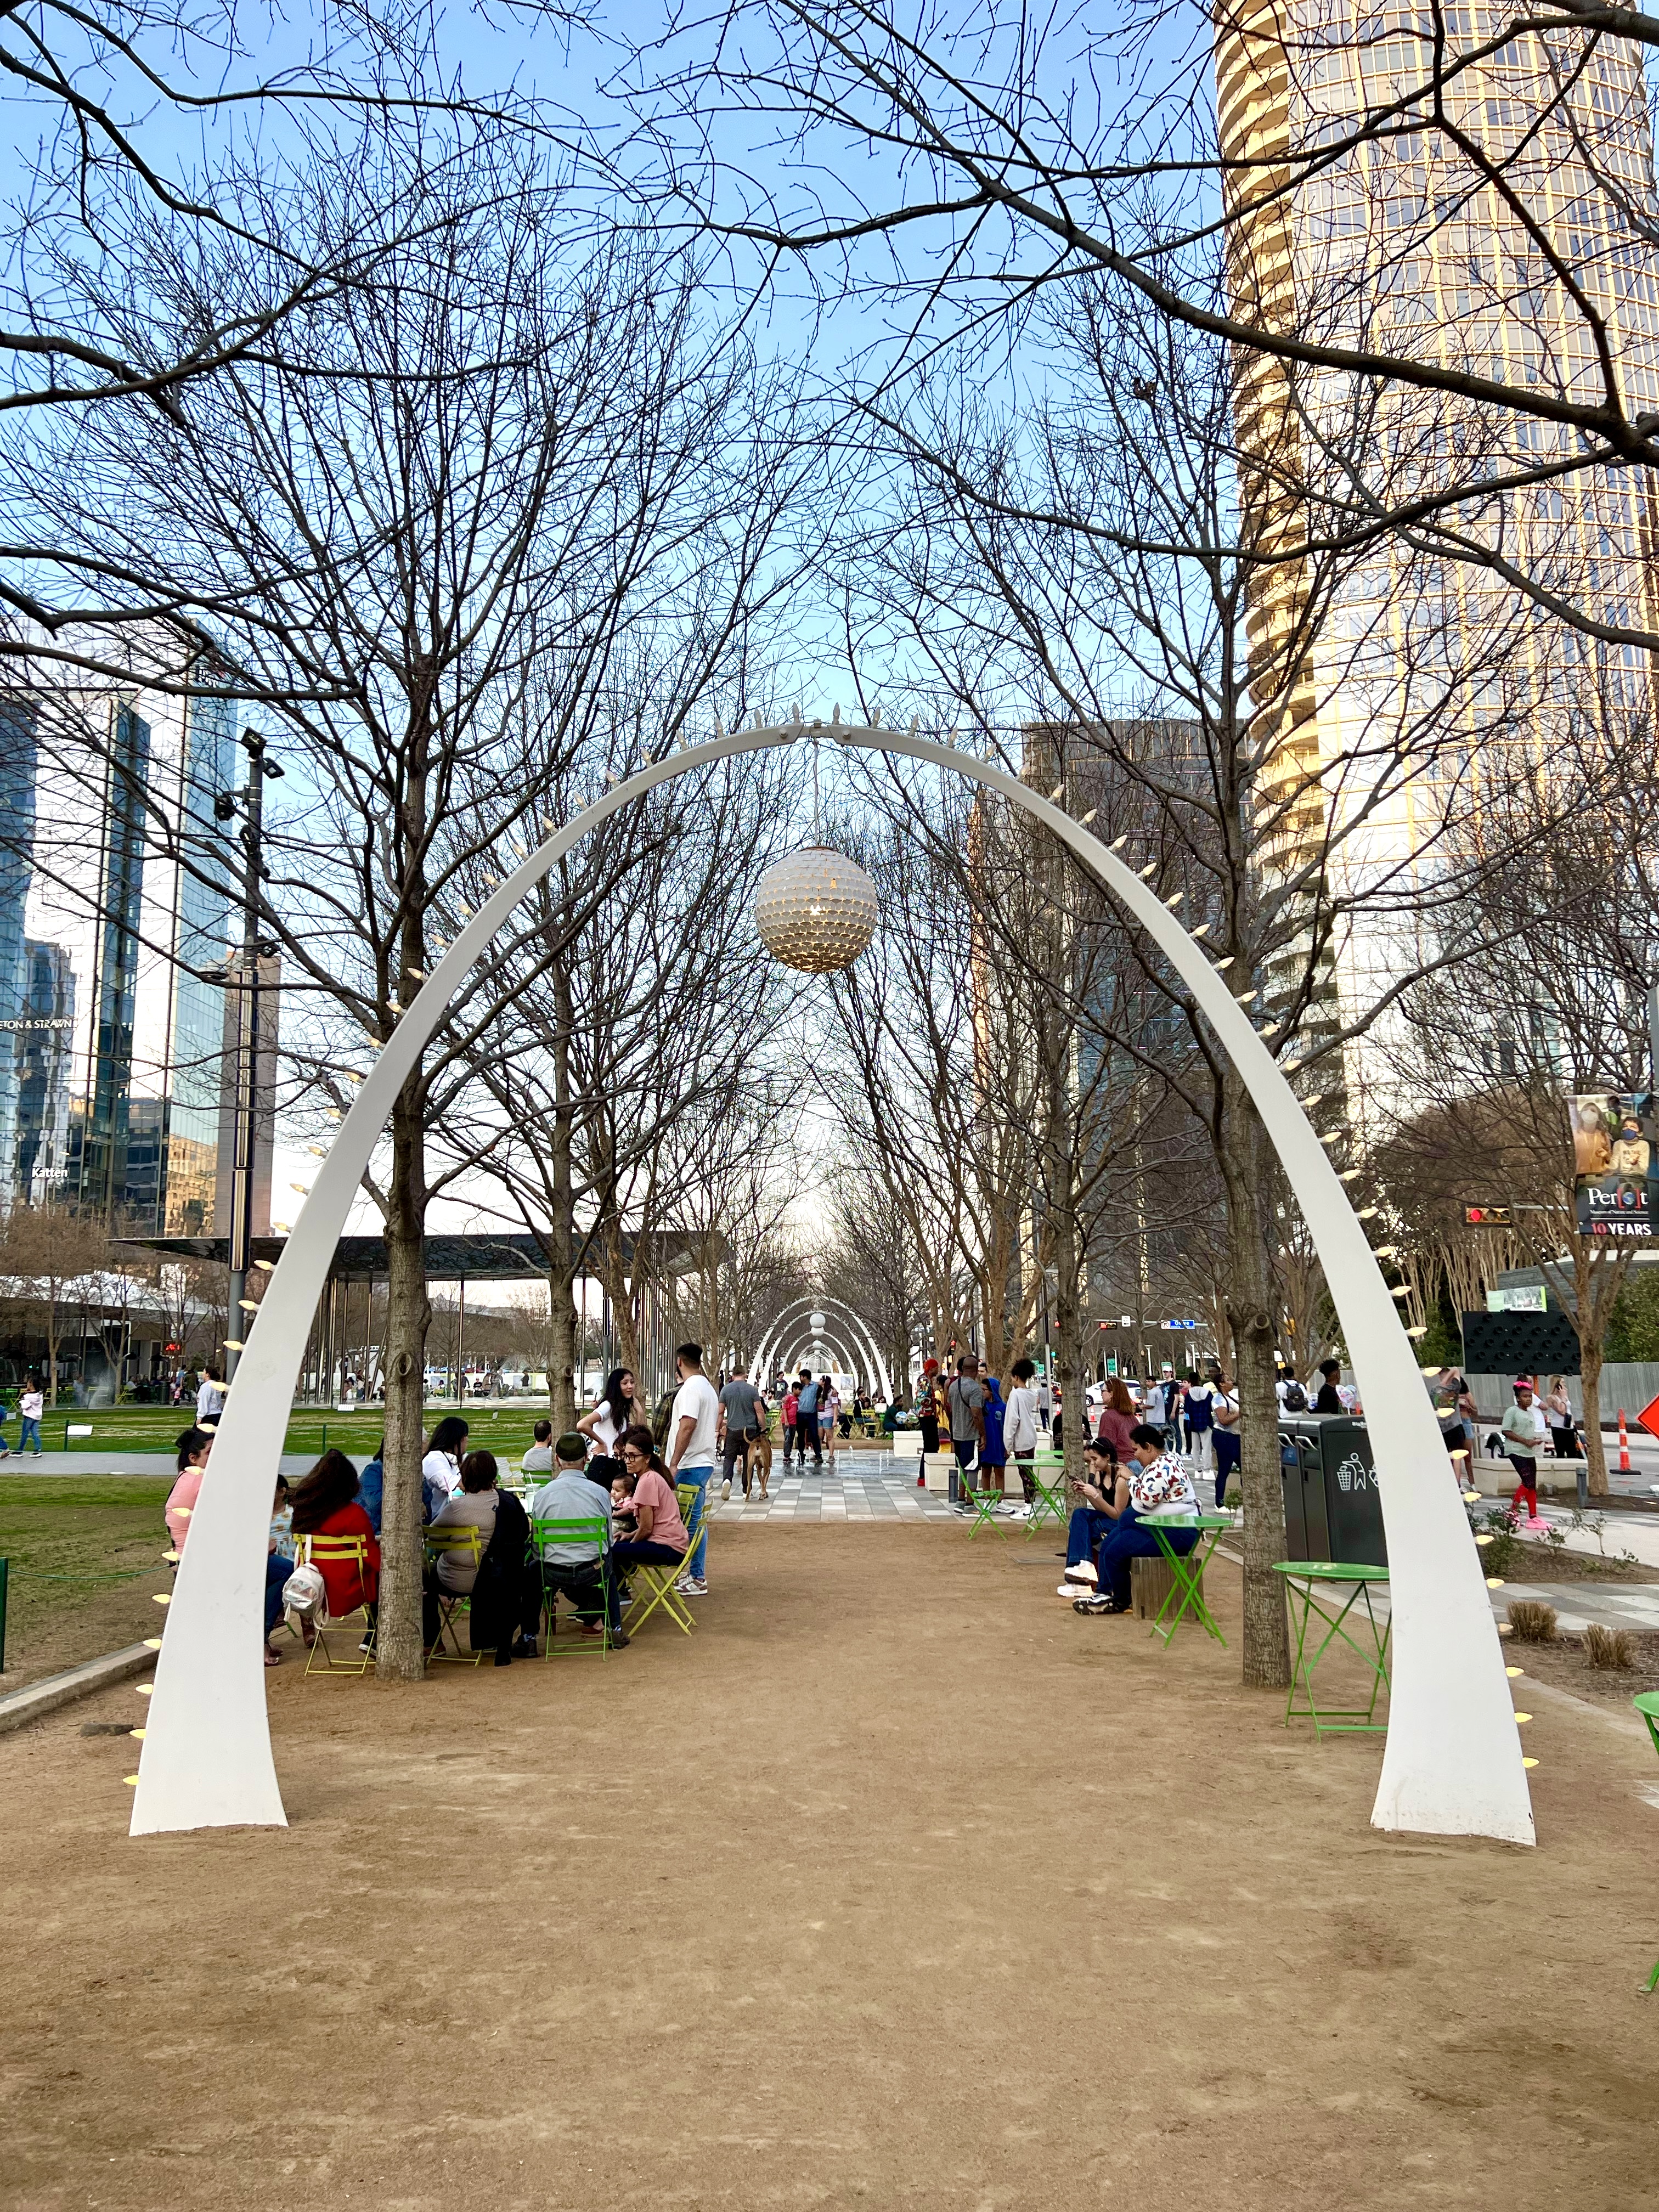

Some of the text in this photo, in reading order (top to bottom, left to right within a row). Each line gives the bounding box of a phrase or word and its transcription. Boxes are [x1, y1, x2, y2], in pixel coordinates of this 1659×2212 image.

[25, 1020, 32, 1029] &
[34, 1019, 72, 1029] STRAWN
[32, 1167, 68, 1177] Katten
[1592, 1223, 1652, 1235] 10 YEARS
